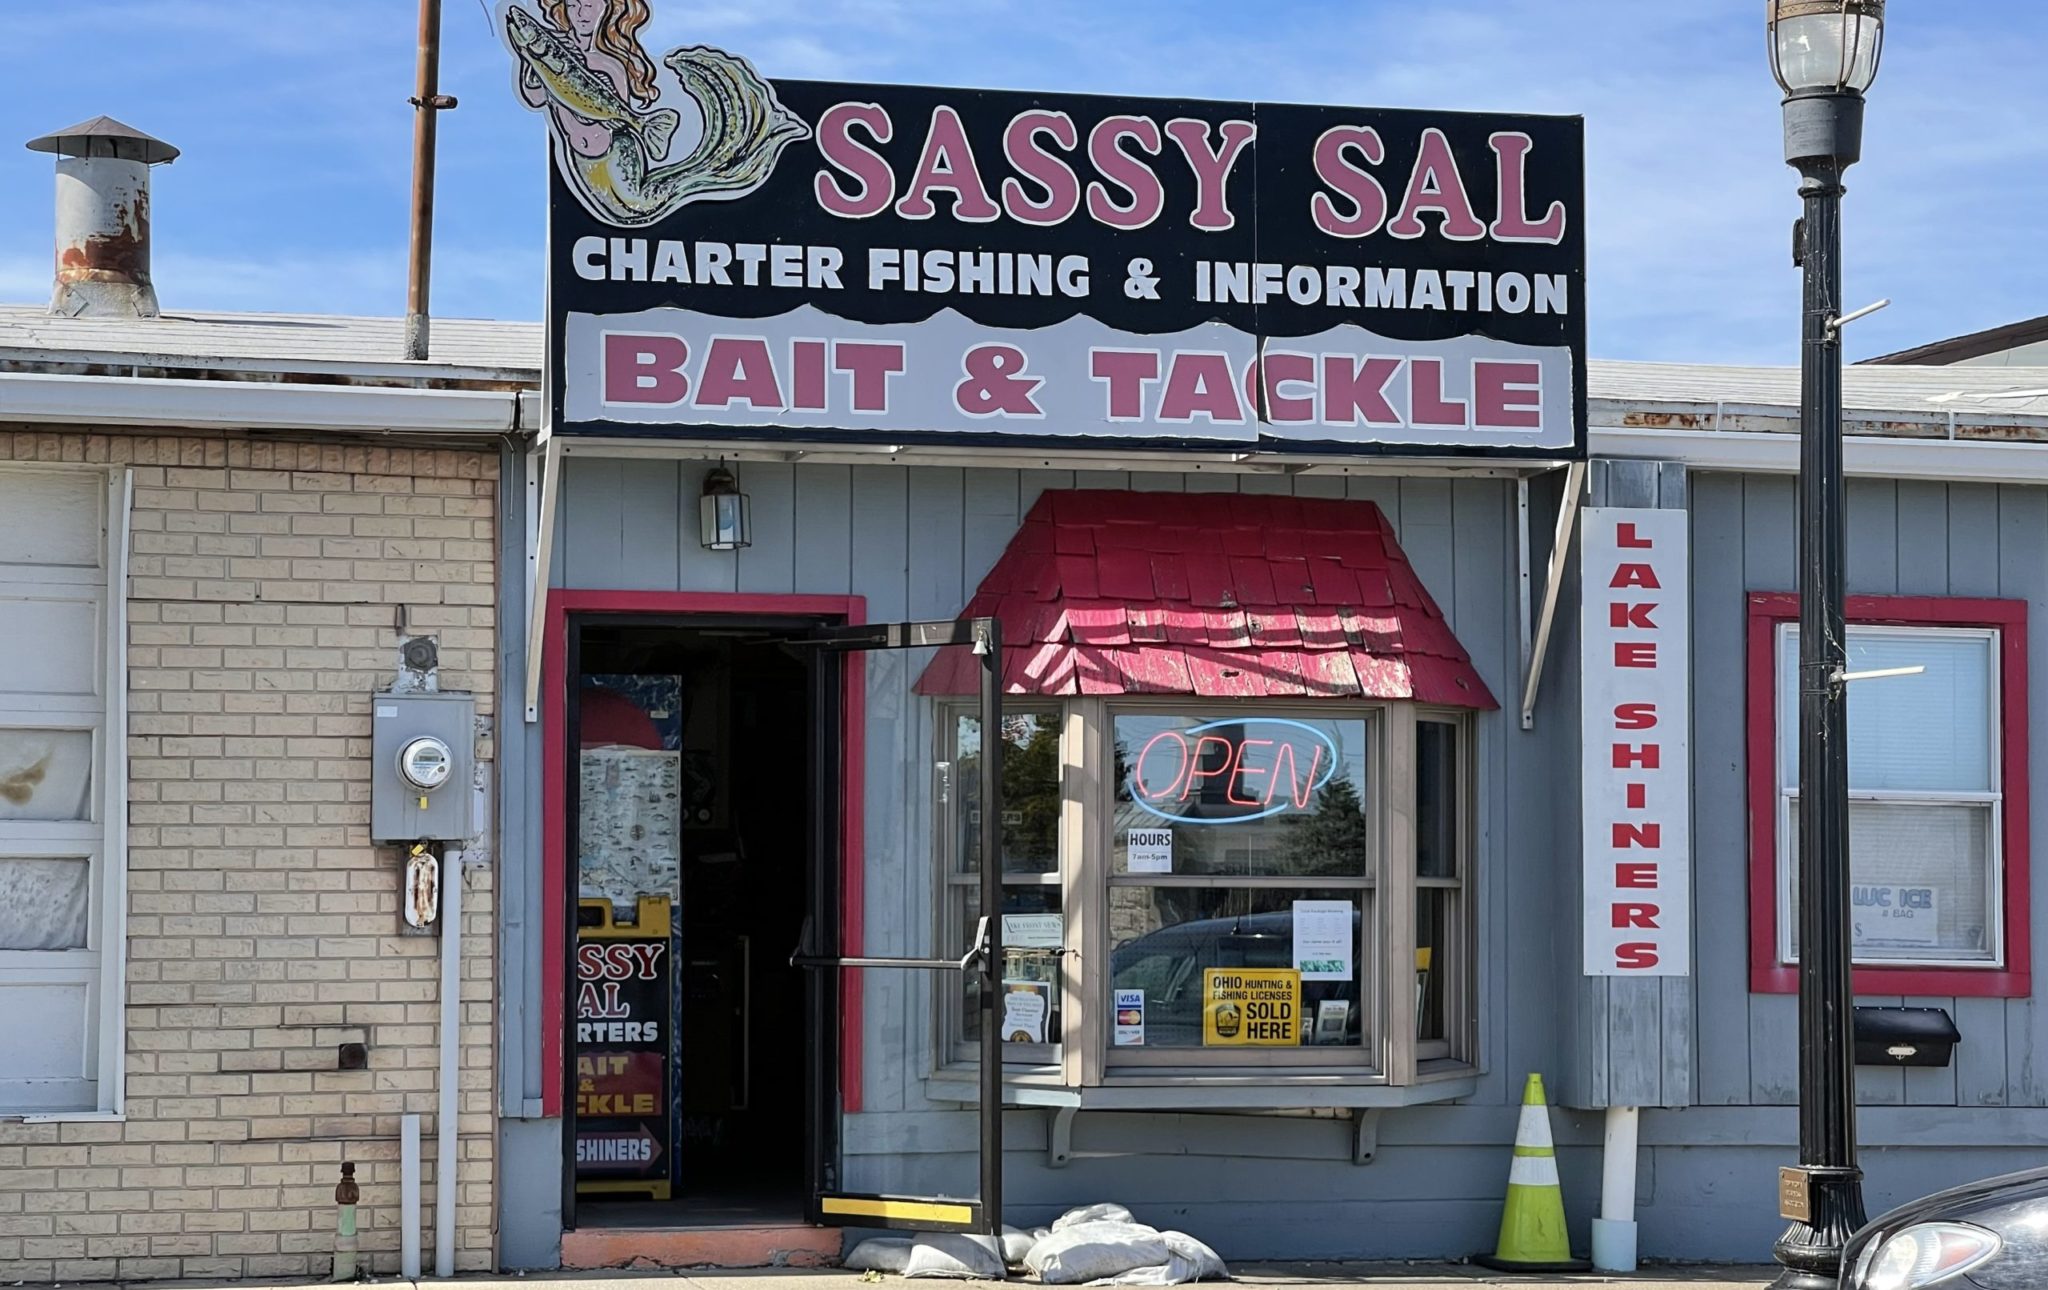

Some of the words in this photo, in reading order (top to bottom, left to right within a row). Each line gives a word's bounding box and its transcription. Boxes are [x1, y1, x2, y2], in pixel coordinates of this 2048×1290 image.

[814, 102, 1257, 231] SASSY
[1311, 125, 1566, 244] SAL
[572, 236, 844, 290] CHARTER
[868, 248, 1090, 298] FISHING
[1124, 258, 1161, 300] &
[1196, 261, 1568, 314] INFORMATION
[600, 329, 906, 416] BAIT
[953, 341, 1047, 420] &
[1089, 346, 1543, 432] TACKLE
[1608, 522, 1662, 669] LAKE
[1137, 732, 1321, 808] OPEN
[1130, 833, 1171, 846] HOURS
[1611, 703, 1661, 970] SHINERS
[1899, 889, 1932, 908] ICE
[1893, 909, 1914, 919] BAG
[577, 943, 665, 981] SSY
[1213, 976, 1242, 989] OHIO
[1245, 980, 1283, 989] HUNTING
[1286, 981, 1293, 989] &
[577, 982, 630, 1019] AL
[1120, 994, 1141, 1002] VISA
[1213, 991, 1248, 1000] FISHING
[1250, 991, 1292, 1001] LICENSES
[1246, 1002, 1292, 1020] SOLD
[577, 1021, 659, 1042] RTERS
[1247, 1022, 1292, 1039] HERE
[577, 1056, 629, 1075] AIT
[577, 1138, 651, 1161] SHINERS
